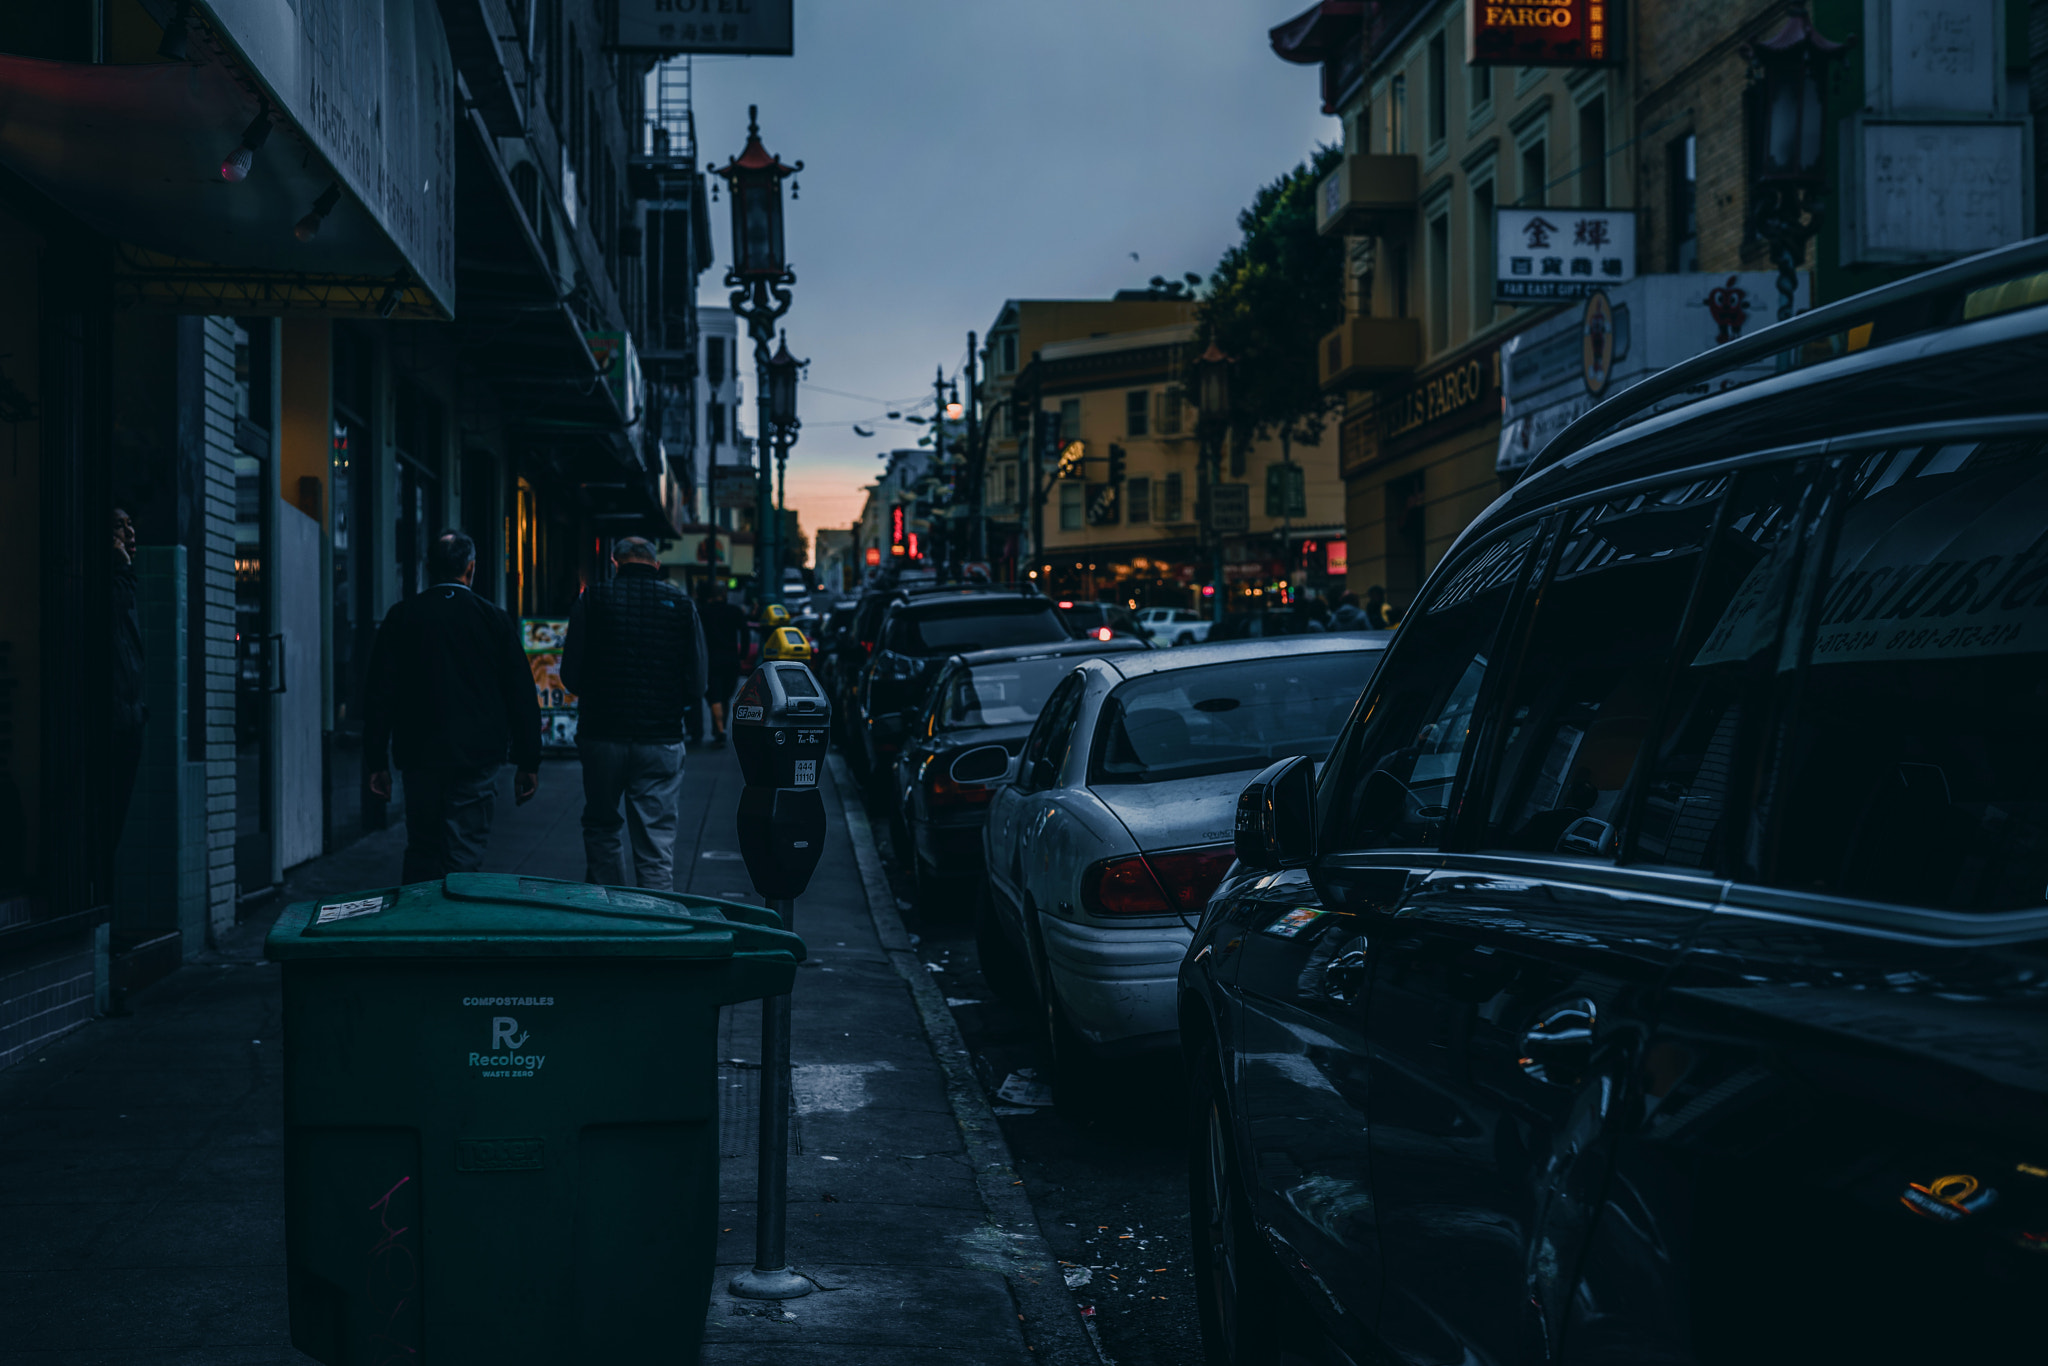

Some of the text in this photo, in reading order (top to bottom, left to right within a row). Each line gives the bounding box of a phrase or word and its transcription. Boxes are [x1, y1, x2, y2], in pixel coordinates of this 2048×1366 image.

[656, 0, 752, 14] HOTEL
[1485, 6, 1572, 28] FARGO
[310, 77, 371, 189] 415-576-1818
[1527, 283, 1555, 297] EAST
[1427, 360, 1481, 421] FARGO
[797, 762, 813, 771] 444
[795, 773, 815, 782] 11110
[463, 997, 554, 1006] COMPOSTABLES
[469, 1051, 545, 1070] Recology
